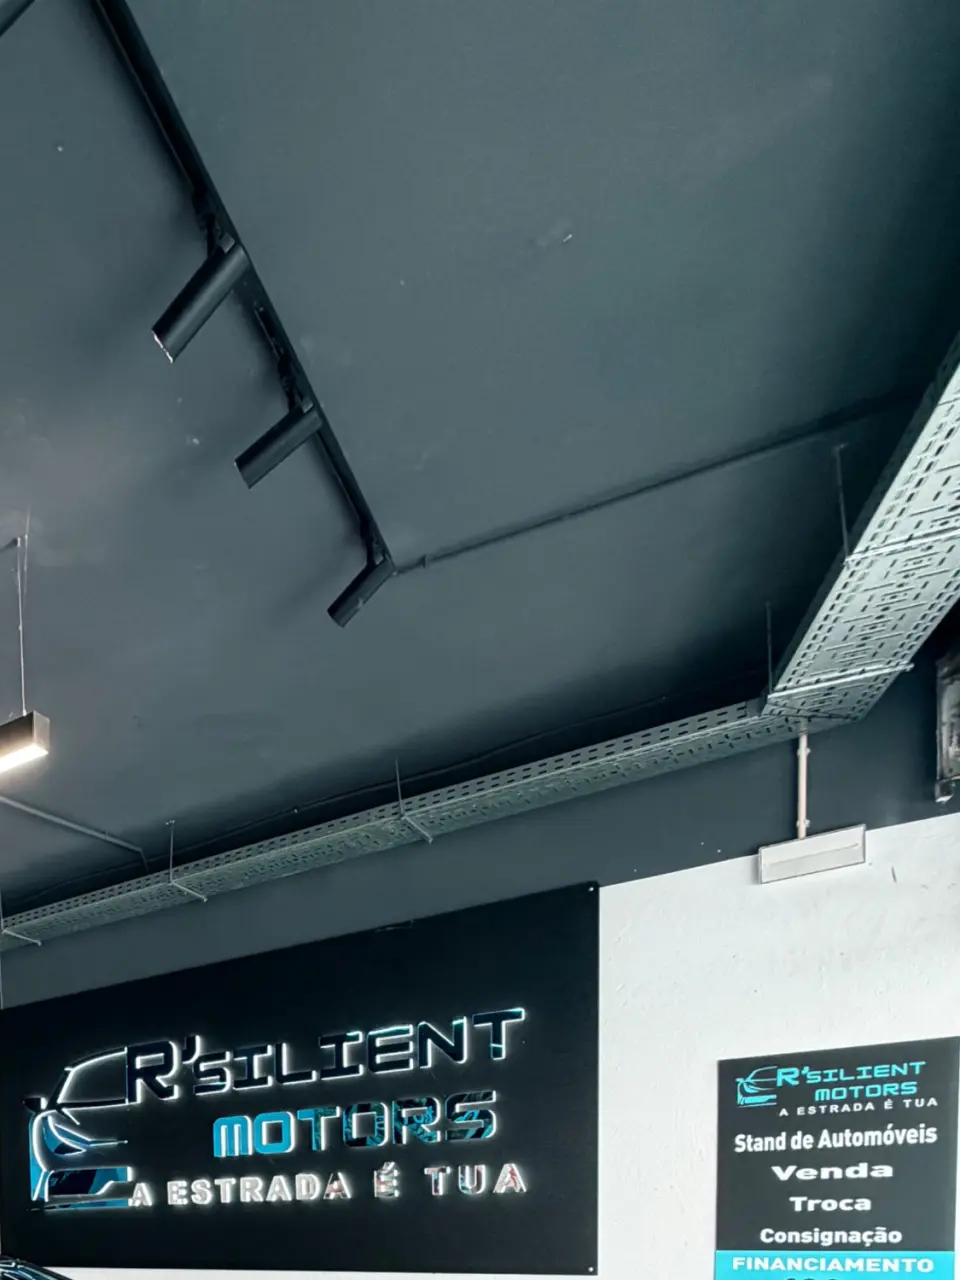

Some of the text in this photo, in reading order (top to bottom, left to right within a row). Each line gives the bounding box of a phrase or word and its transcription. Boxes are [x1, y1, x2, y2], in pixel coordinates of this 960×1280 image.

[814, 1081, 918, 1102] MOTORS
[778, 1097, 939, 1117] A ESTRADA É TUA
[213, 1090, 497, 1158] MOTORS
[734, 1123, 938, 1153] Stand de Automóveis
[771, 1162, 894, 1181] Venda
[128, 1160, 527, 1207] A ESTRADA É TUA
[789, 1196, 872, 1212] Troca
[759, 1226, 903, 1247] Consignação
[731, 1256, 934, 1273] FINANCIAMENTO
